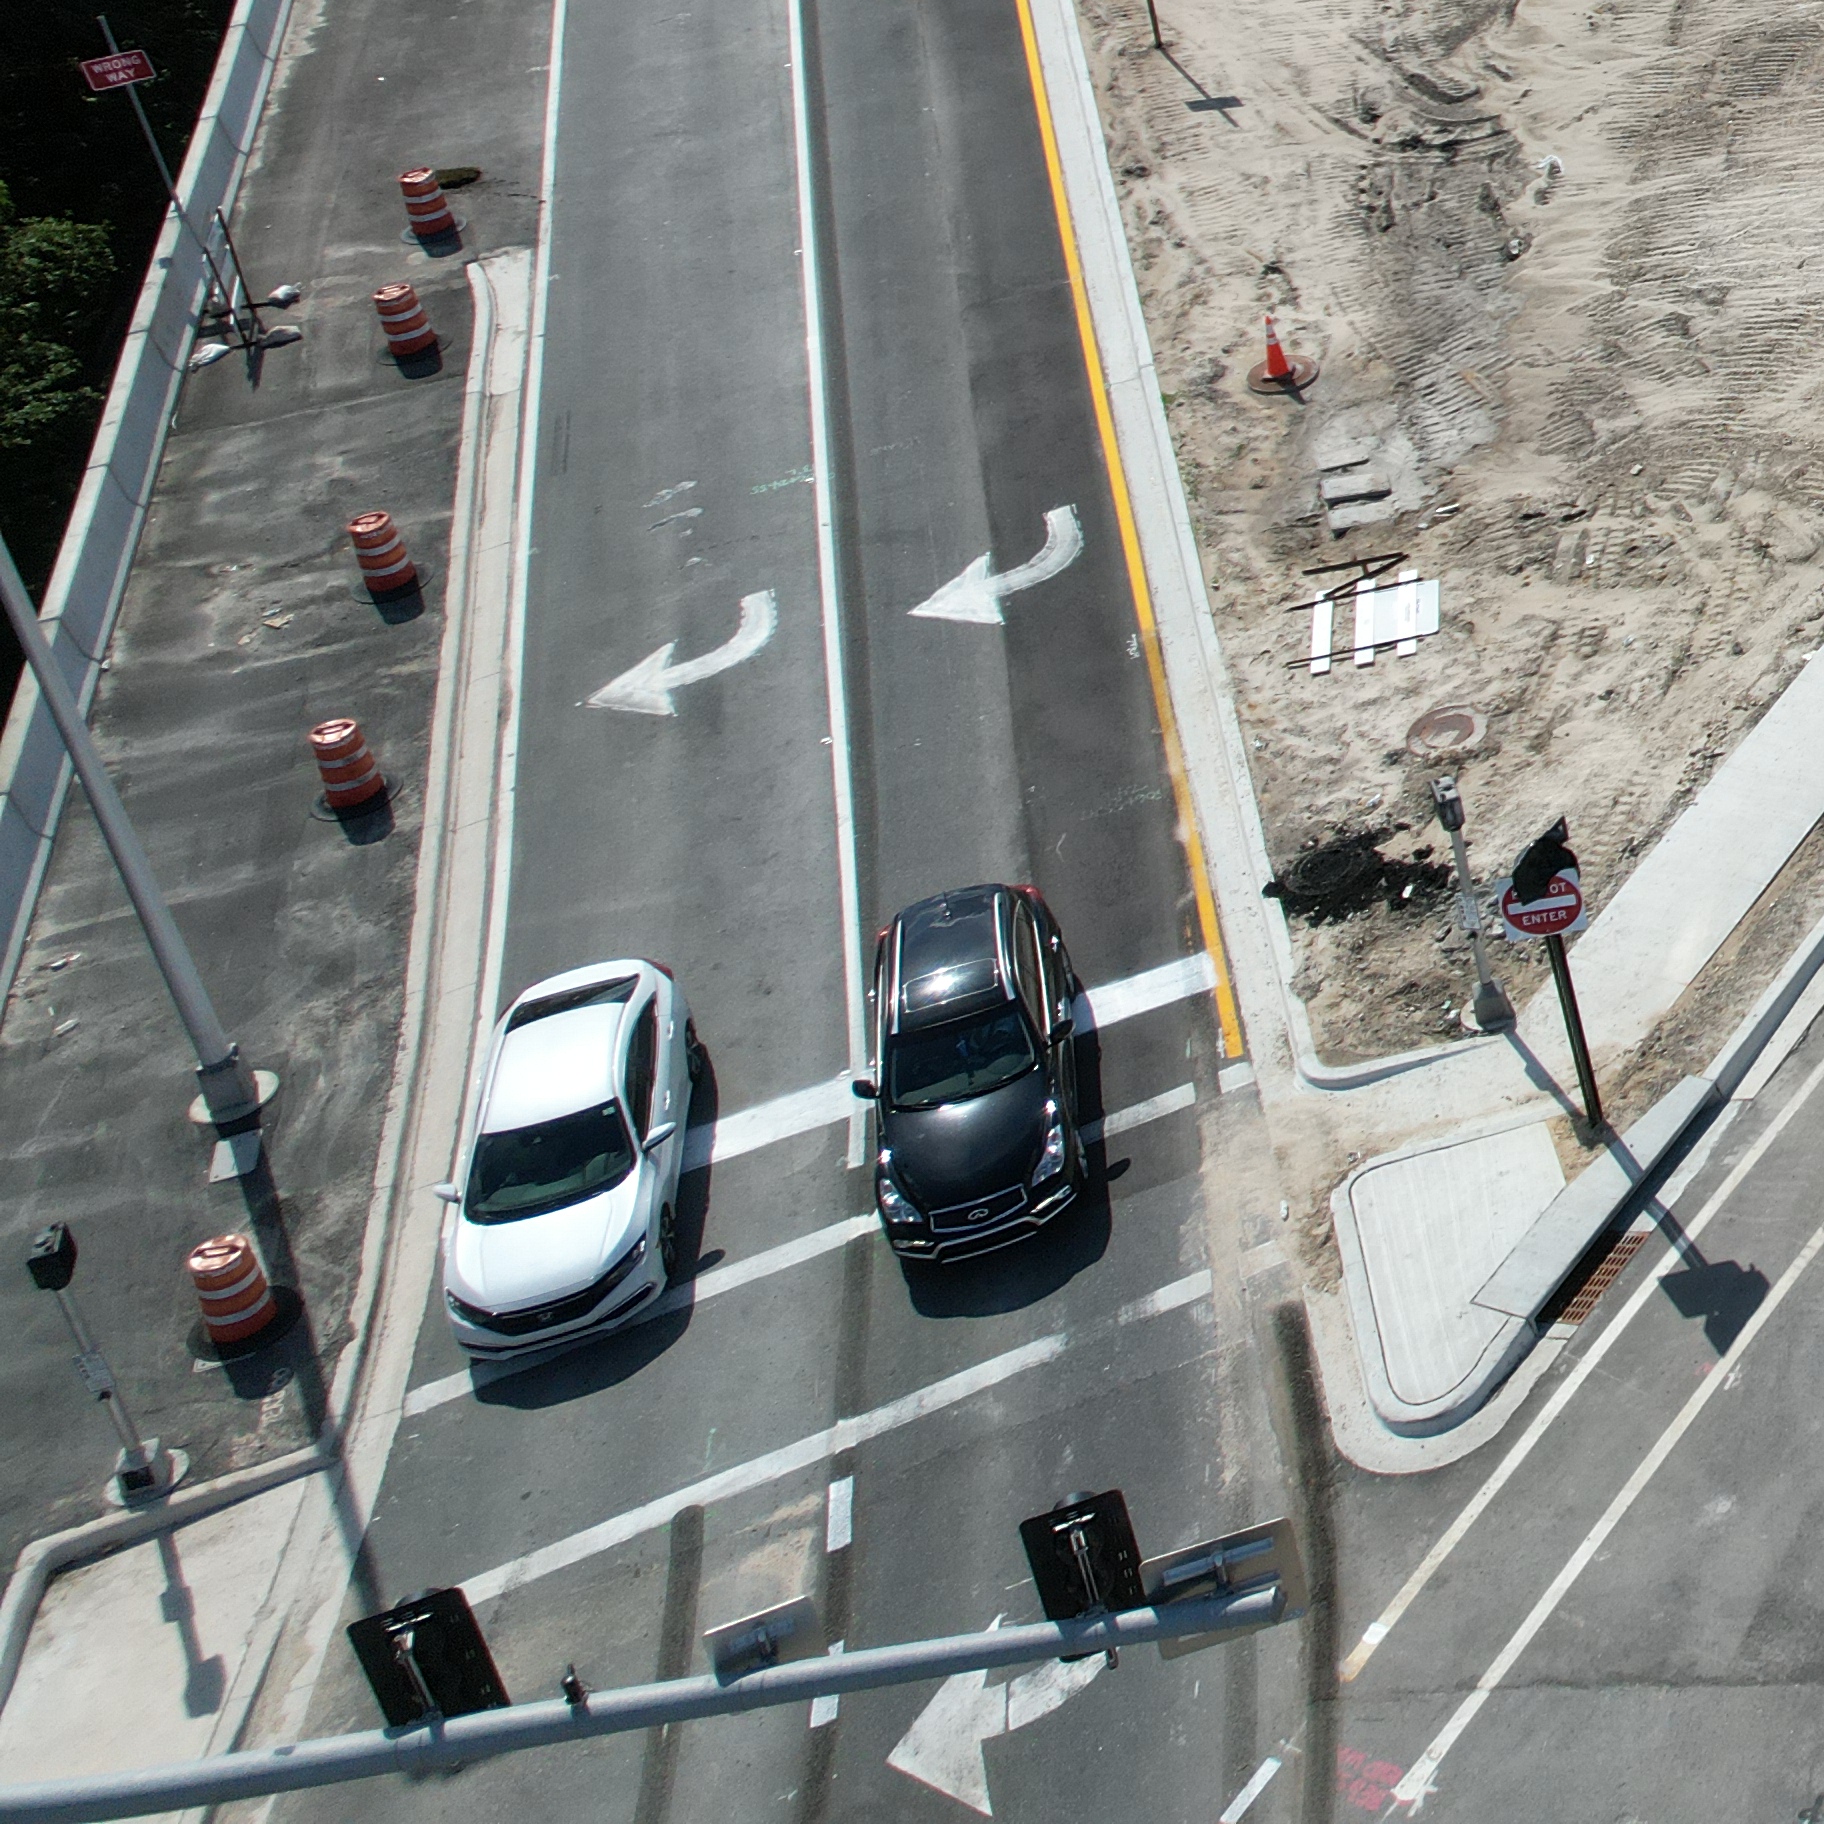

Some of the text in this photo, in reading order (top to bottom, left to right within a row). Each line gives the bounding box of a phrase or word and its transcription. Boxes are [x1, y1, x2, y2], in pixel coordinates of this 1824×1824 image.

[91, 55, 141, 73] WRONG
[106, 68, 136, 82] WAY
[1522, 910, 1567, 926] ENTER
